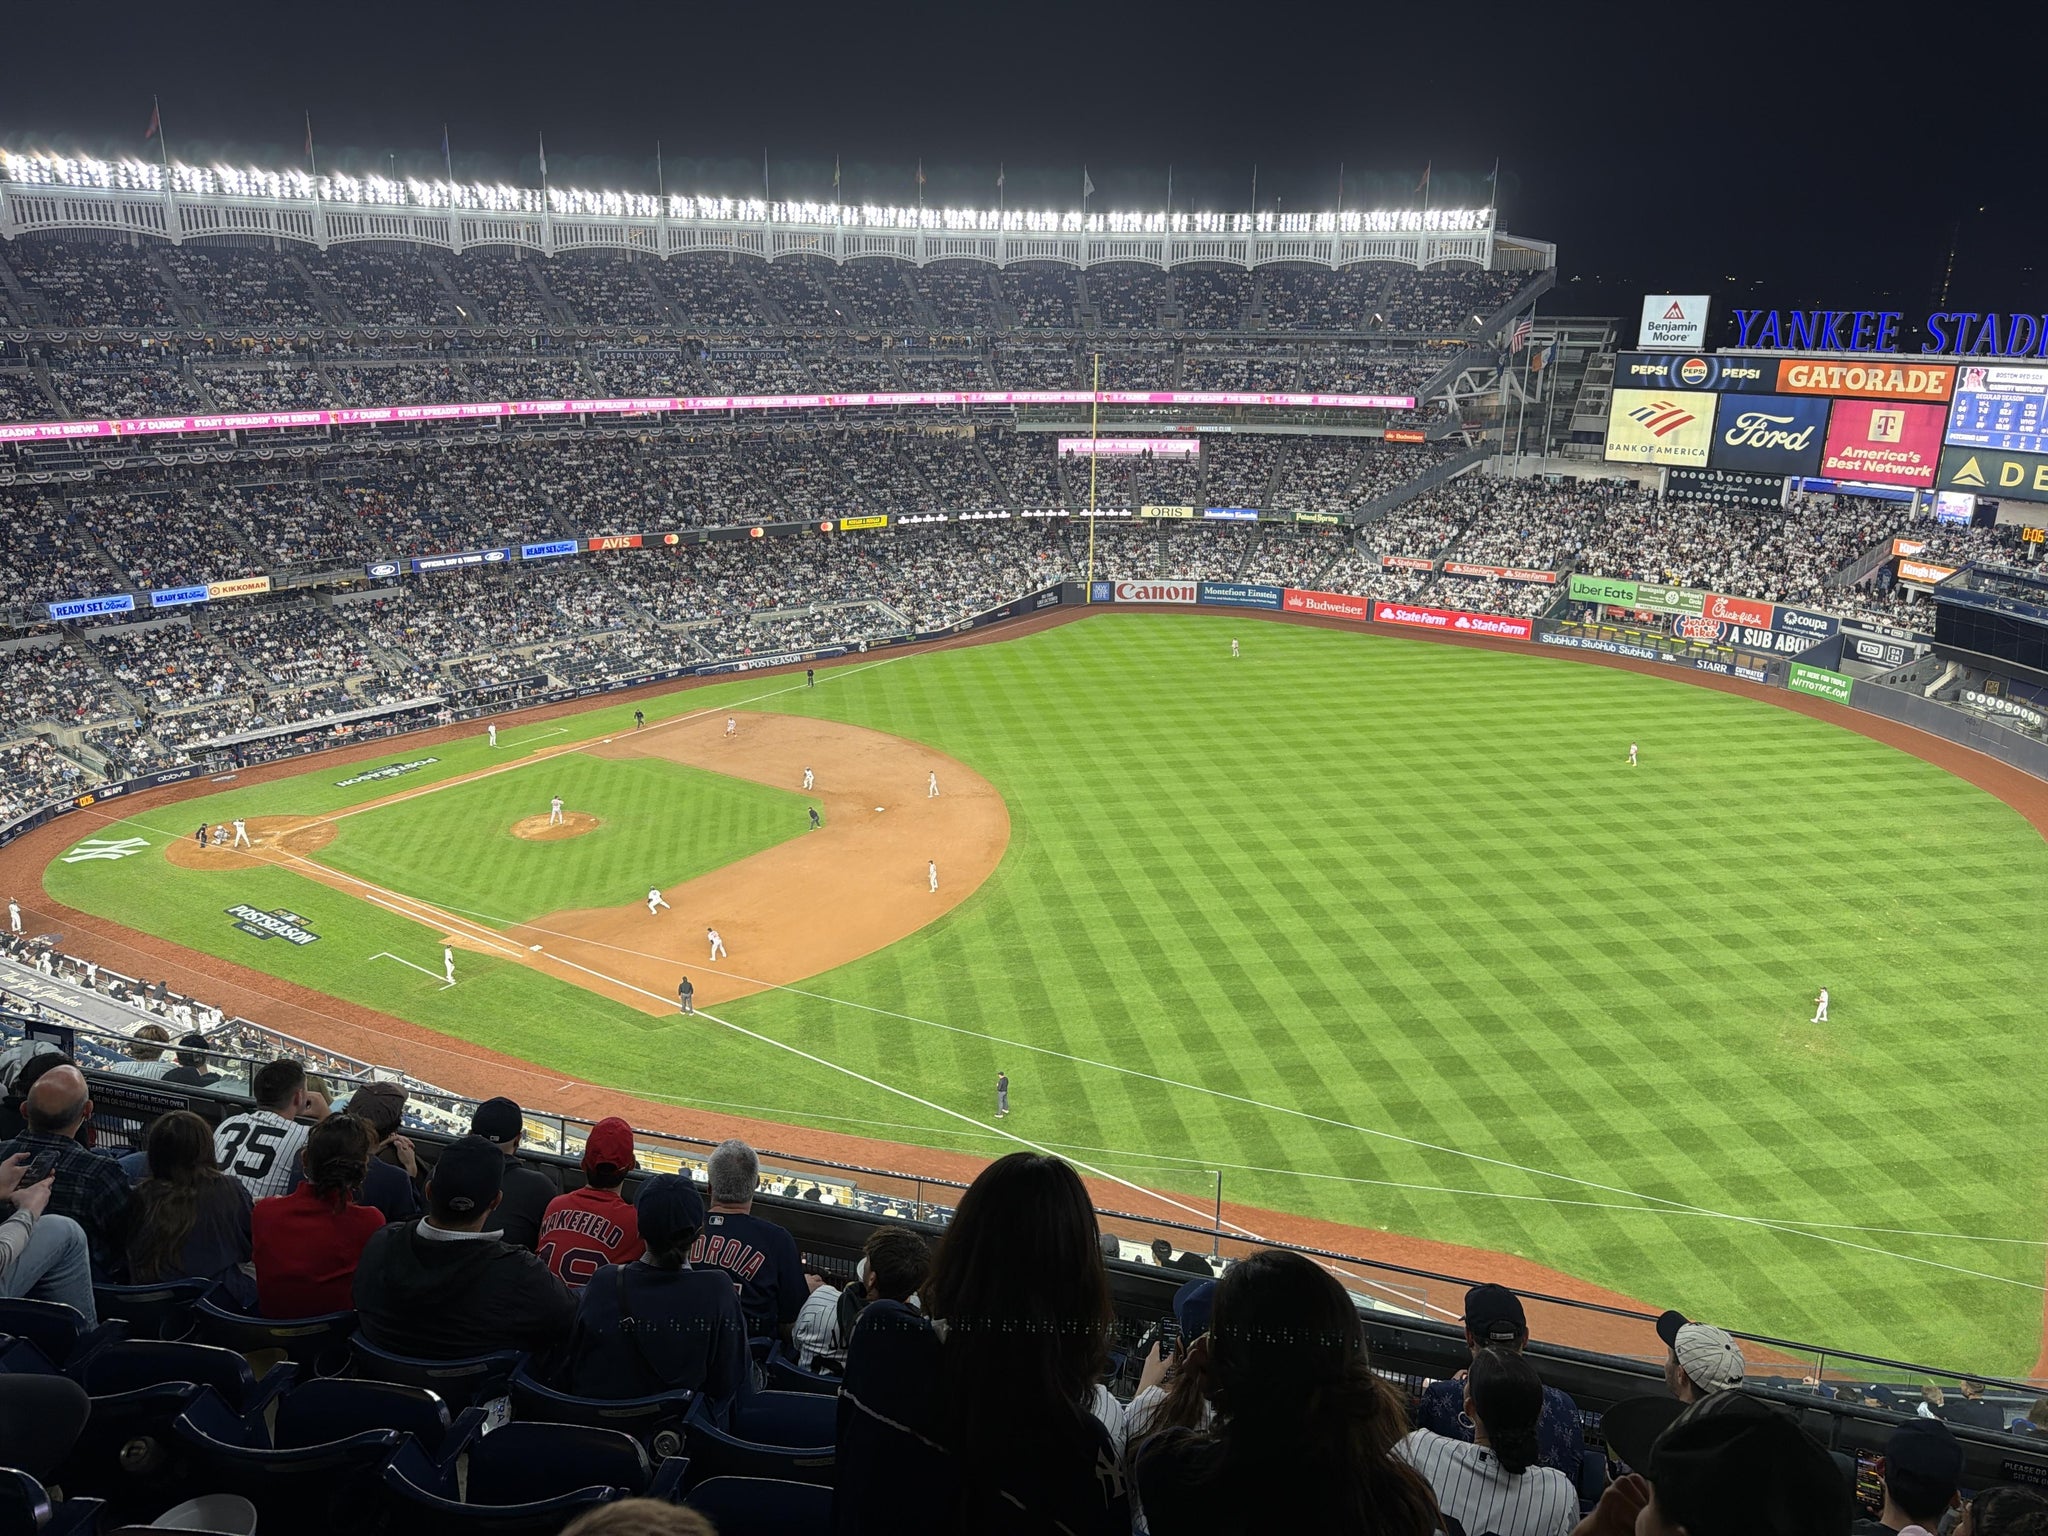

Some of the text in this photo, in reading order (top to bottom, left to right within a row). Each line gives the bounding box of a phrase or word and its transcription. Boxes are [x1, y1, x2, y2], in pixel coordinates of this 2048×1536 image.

[1648, 321, 1697, 333] Benjamin
[1732, 309, 1901, 351] YANKEE
[1652, 332, 1687, 342] Moore
[1631, 365, 1668, 376] PEPSI
[1722, 368, 1760, 379] PEPSI
[1787, 365, 1948, 395] GATORADE
[194, 418, 223, 427] START
[0, 425, 99, 438] EADIN' THE BREWS
[1725, 412, 1815, 451] Ford
[1609, 444, 1705, 456] BANK OF AMERICA
[1840, 446, 1921, 463] America's
[1826, 457, 1932, 477] Best Network
[1151, 508, 1183, 516] ORIS
[1317, 515, 1338, 524] Spring
[2022, 528, 2044, 543] 0:06
[602, 538, 630, 548] AVIS
[527, 546, 544, 556] READY
[546, 545, 557, 553] SET
[222, 582, 266, 592] KIKKOMAN
[1116, 583, 1194, 600] Canon
[1205, 587, 1277, 599] Montefiore Einstein
[1573, 583, 1602, 596] Uber
[1604, 587, 1633, 600] Eats
[156, 594, 176, 602] READY
[57, 600, 127, 616] READY SET Ford
[1306, 598, 1362, 615] Budweiser
[1712, 599, 1761, 624] Chick-fil-A
[1682, 616, 1720, 630] Jersey
[1798, 616, 1827, 630] coupa
[1542, 634, 1578, 646] StubHub
[1730, 626, 1772, 648] A SUB
[1581, 640, 1617, 652] StubHub
[1618, 646, 1653, 659] StubHub
[1862, 644, 1879, 654] YES
[750, 655, 800, 669] POSTSEASON
[1696, 660, 1727, 674] STARR
[1736, 667, 1764, 678] CUTWATER
[1792, 677, 1848, 700] NITTOTIRE.COM
[158, 770, 190, 782] abbvie
[228, 905, 317, 944] POSTSEASON
[88, 1084, 105, 1094] LEASE
[115, 1089, 125, 1097] NOT
[126, 1091, 140, 1100] LEAN
[151, 1096, 168, 1105] REACH
[170, 1100, 185, 1108] OVER
[216, 1122, 288, 1180] 35
[2004, 1462, 2047, 1476] PLEASE DO
